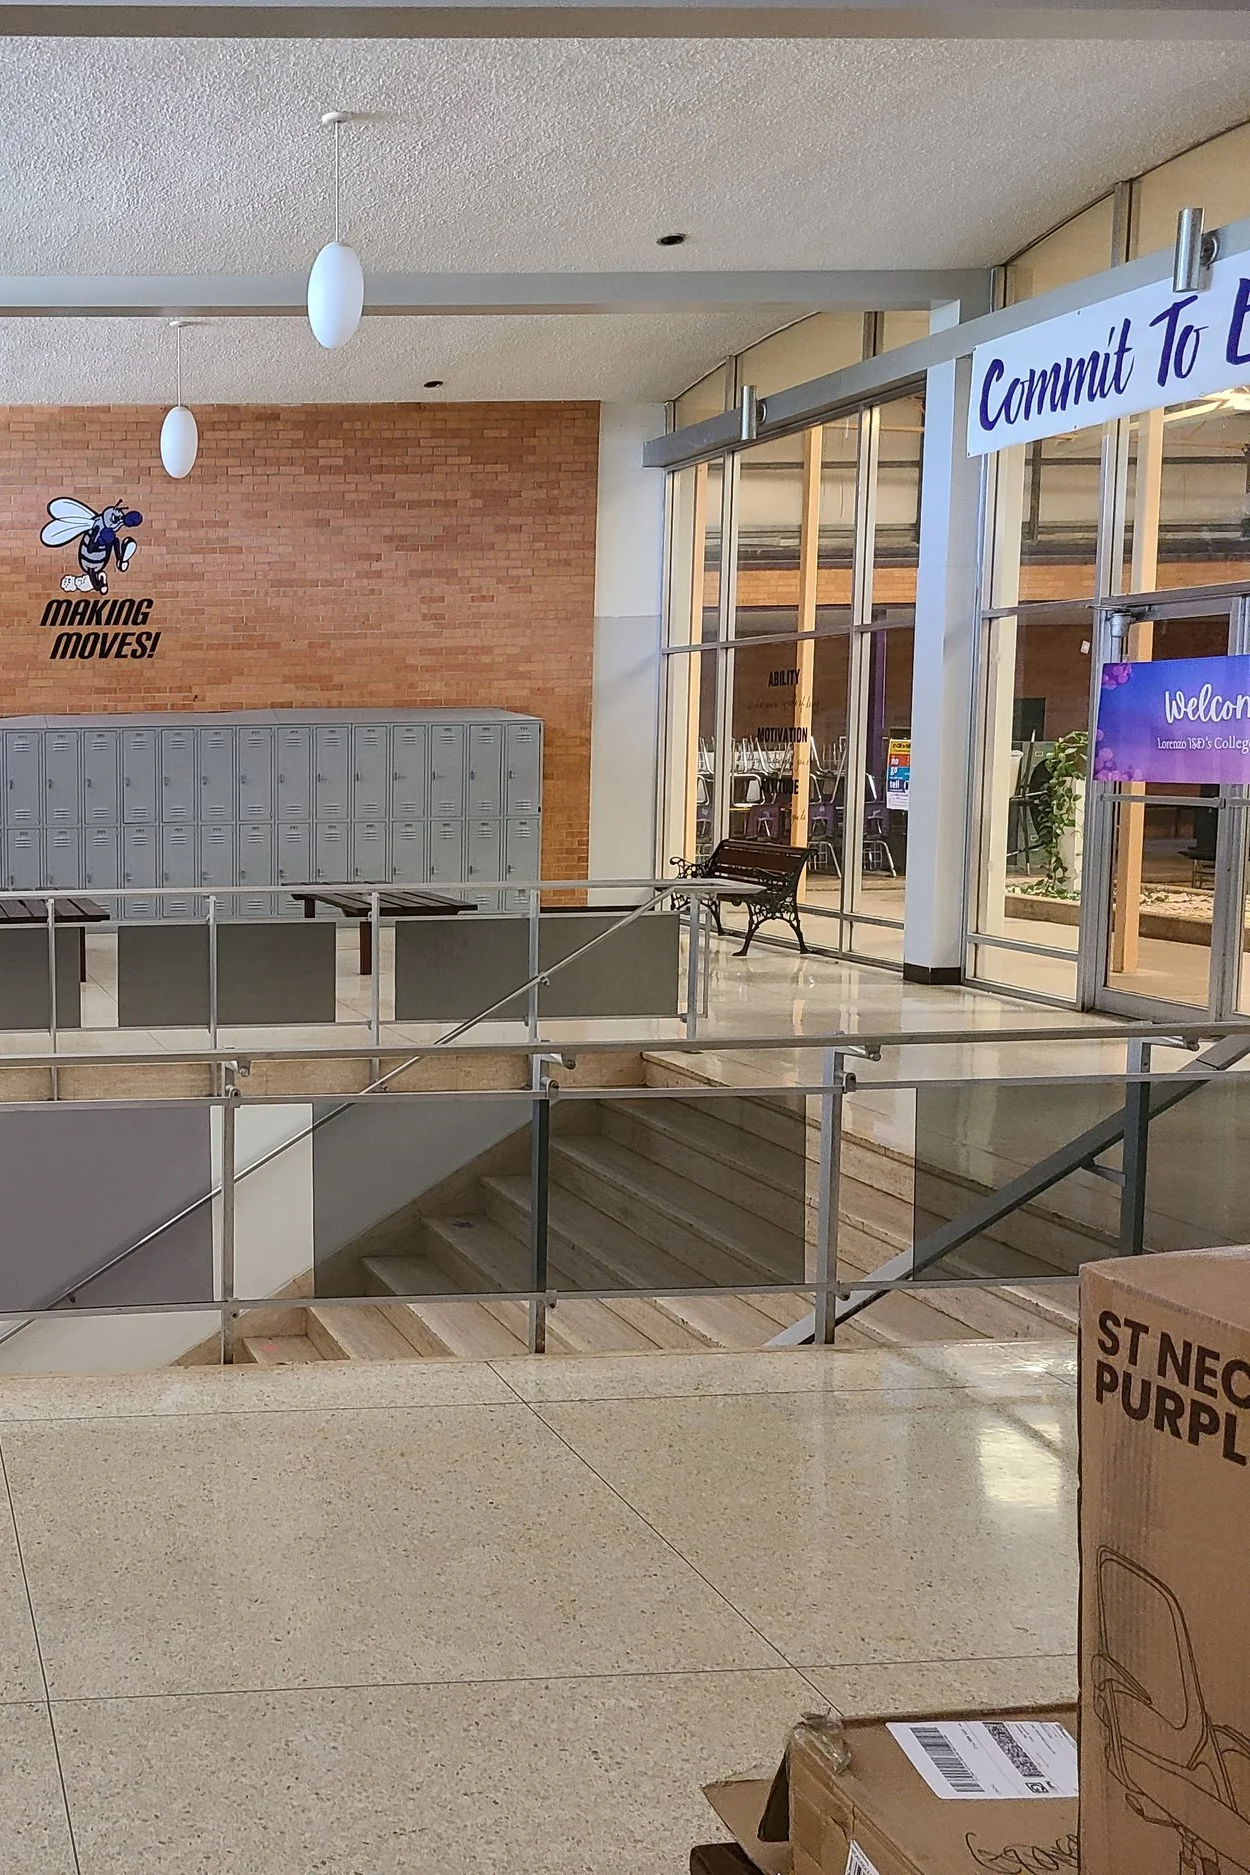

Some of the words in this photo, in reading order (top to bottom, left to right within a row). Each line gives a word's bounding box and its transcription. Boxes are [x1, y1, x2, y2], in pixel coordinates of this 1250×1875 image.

[979, 318, 1135, 431] Commit
[1149, 295, 1210, 388] To
[40, 598, 154, 627] MAKING
[50, 631, 162, 660] MOVES!
[768, 669, 800, 687] ABILITY
[757, 727, 808, 743] MOTIVATION
[1157, 737, 1187, 749] Lorenzo
[1098, 1310, 1149, 1367] ST
[1157, 1331, 1250, 1410] NEC
[1096, 1359, 1247, 1467] PURPL
